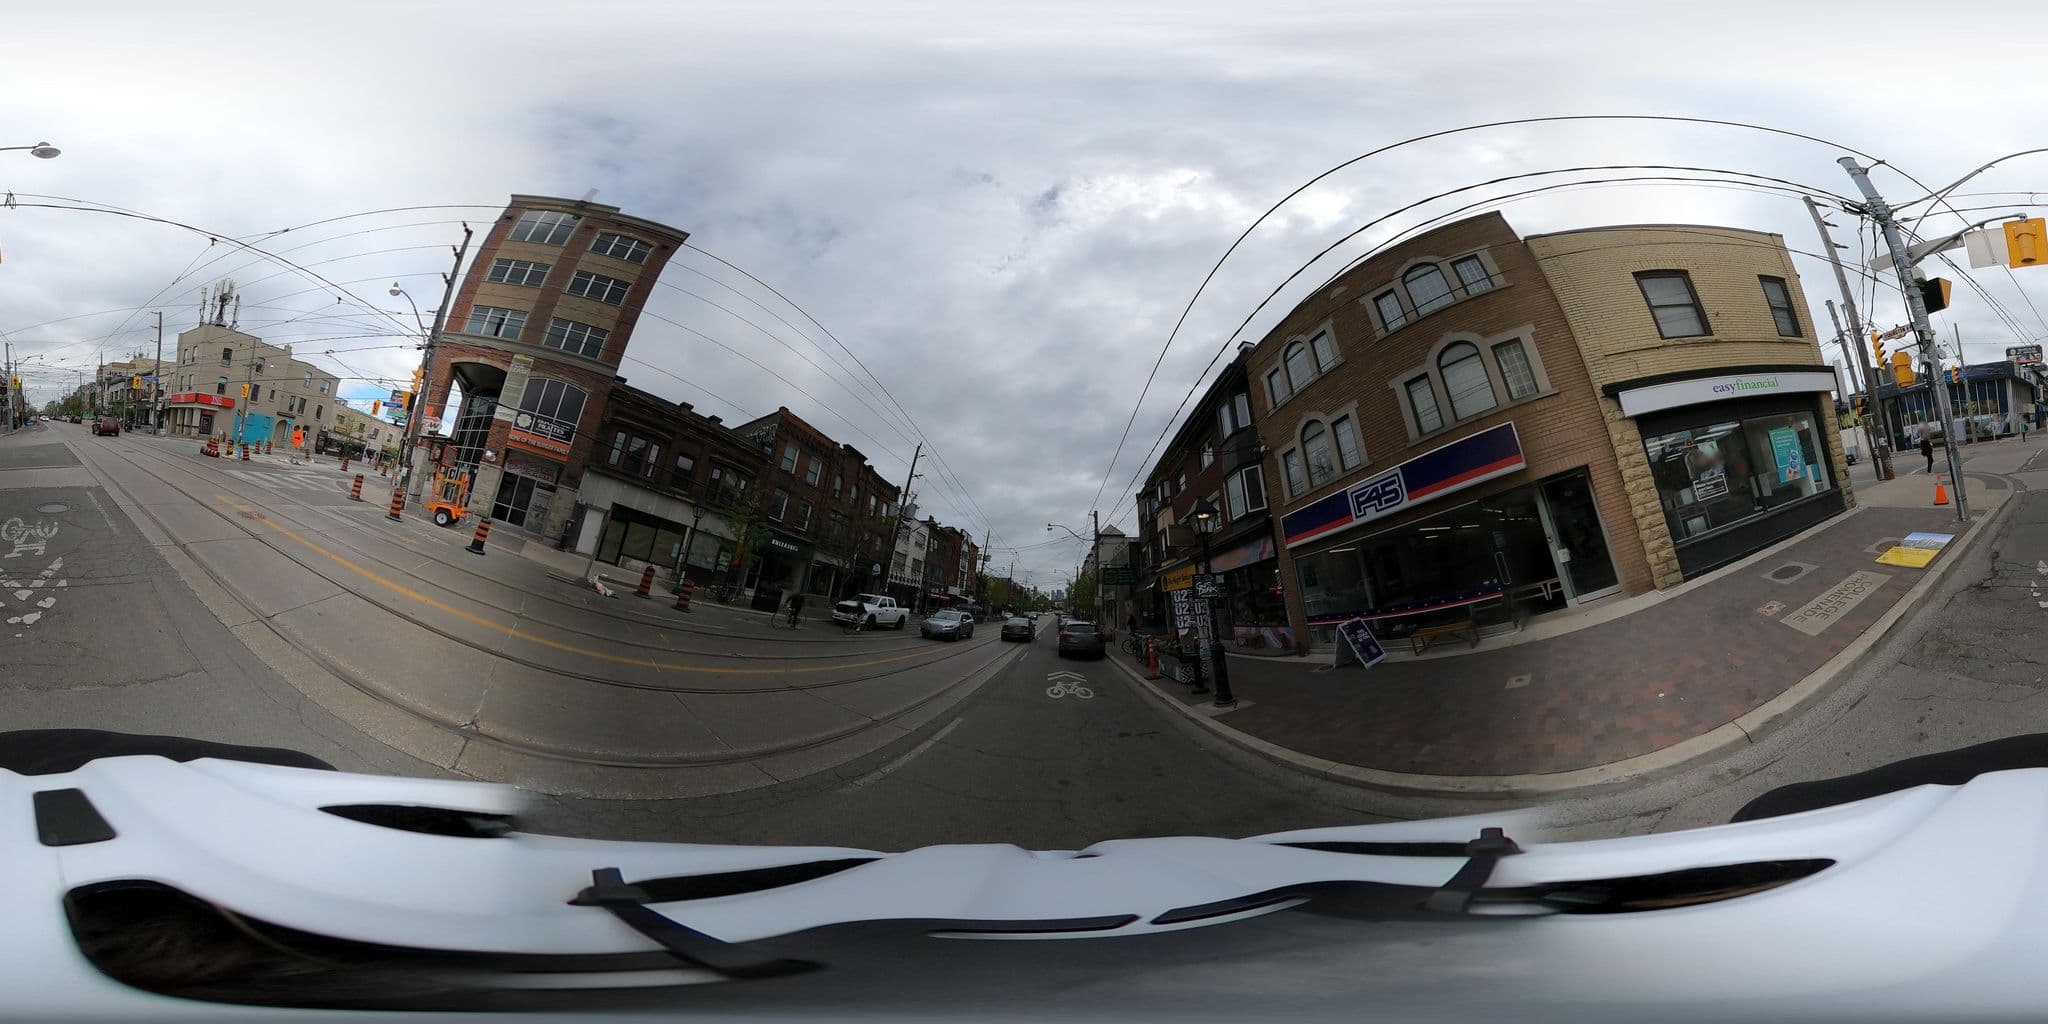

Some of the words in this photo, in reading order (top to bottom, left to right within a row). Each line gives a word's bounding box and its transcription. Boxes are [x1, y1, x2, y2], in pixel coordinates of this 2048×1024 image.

[1712, 376, 1779, 395] easyfinancial
[538, 423, 565, 435] PILATES
[1350, 472, 1405, 519] F45
[1792, 573, 1866, 624] PROMENADE
[1817, 579, 1873, 621] COLLEGE
